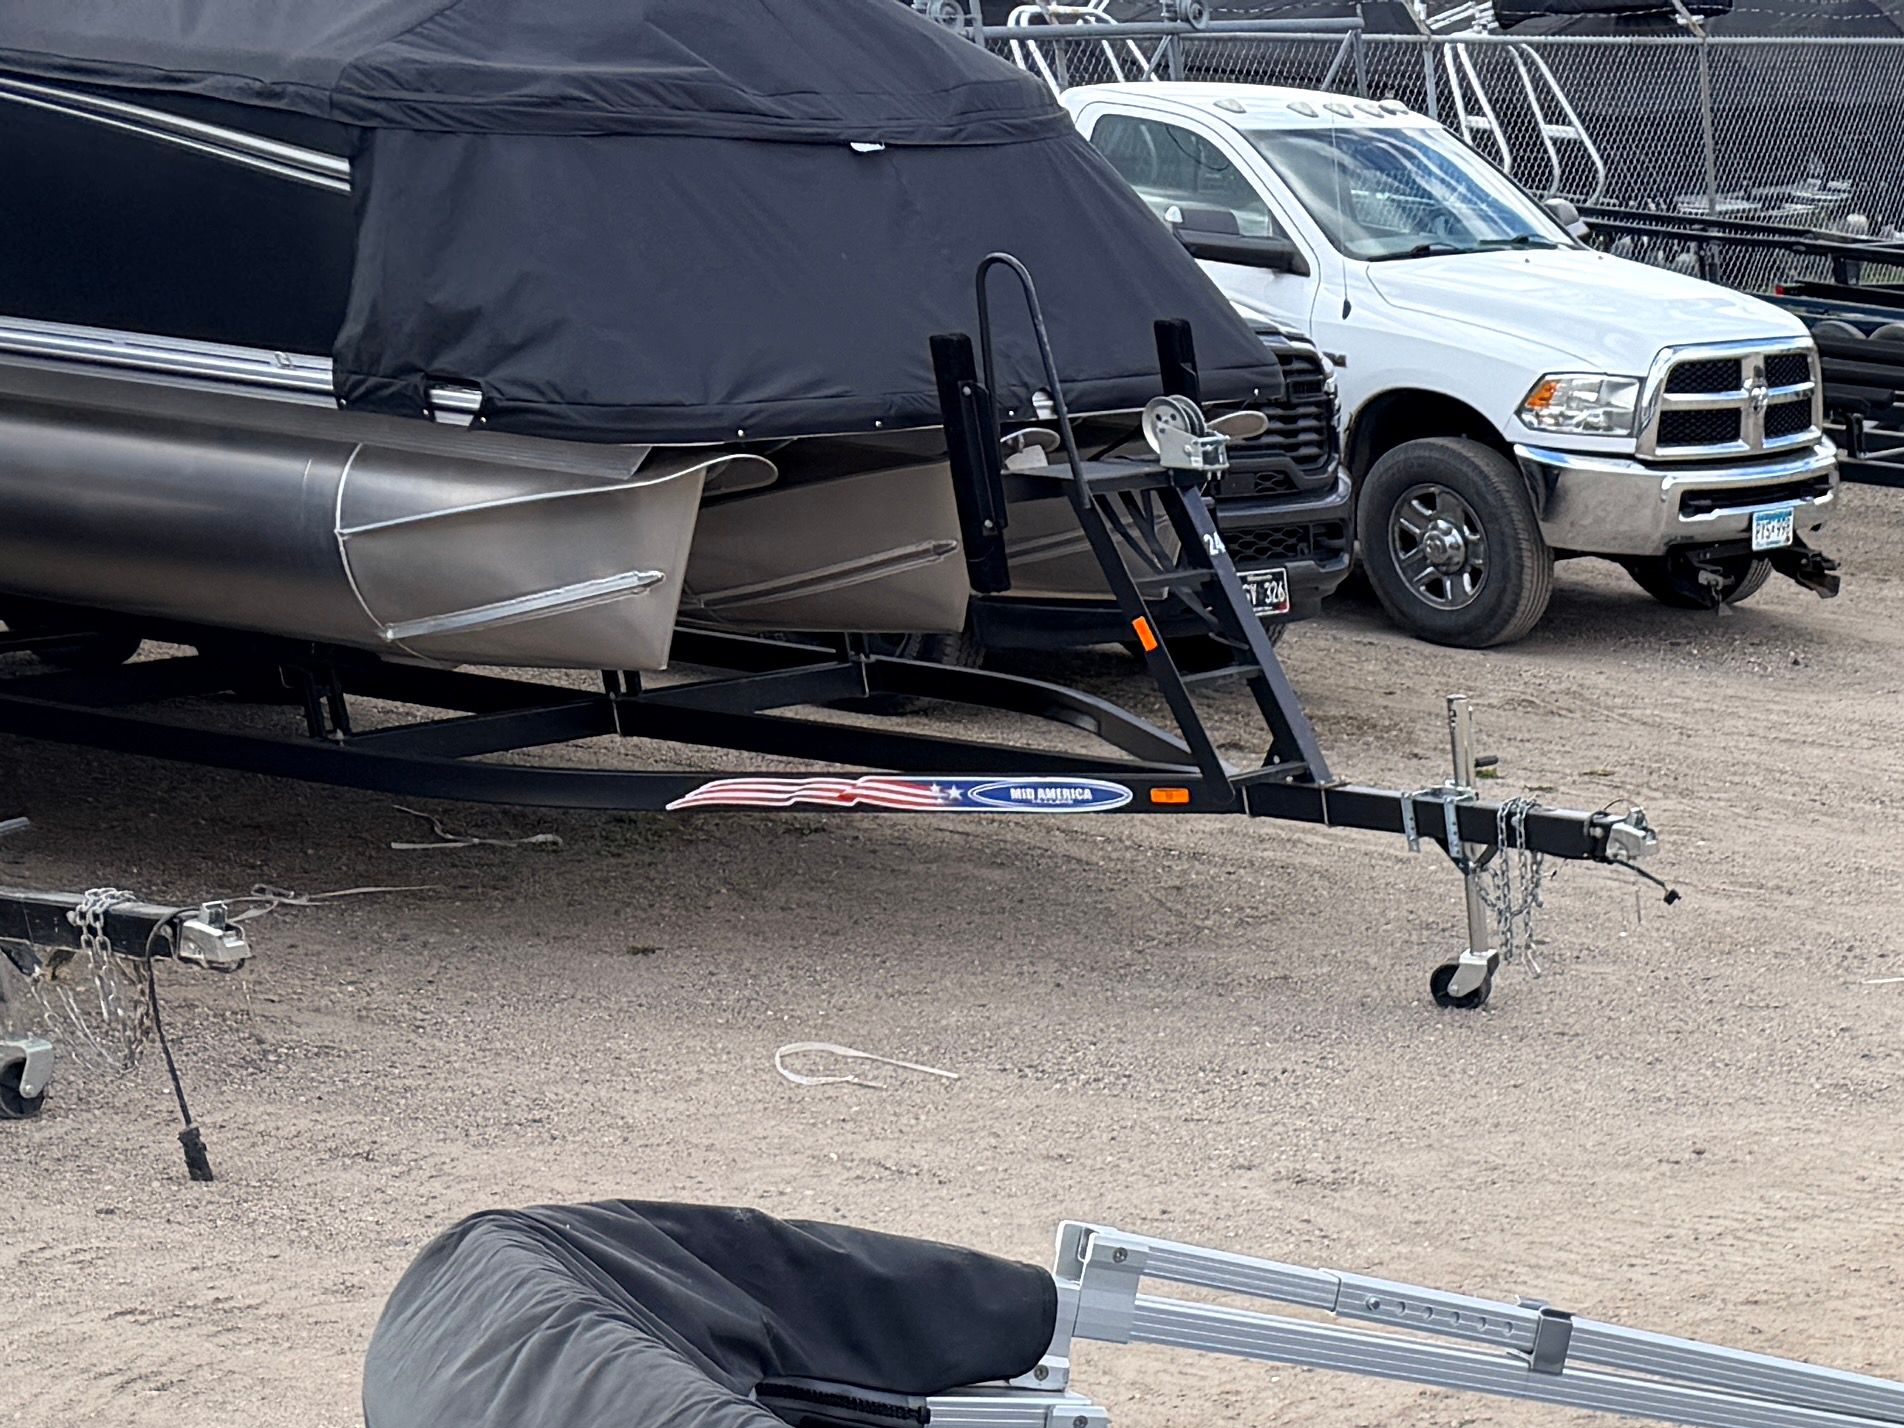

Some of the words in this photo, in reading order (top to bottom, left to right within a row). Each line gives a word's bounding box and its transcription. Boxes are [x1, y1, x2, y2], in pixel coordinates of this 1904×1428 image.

[1203, 531, 1227, 556] 24
[1263, 580, 1286, 604] 326
[1010, 787, 1034, 800] MID
[1037, 787, 1093, 800] AMERICA
